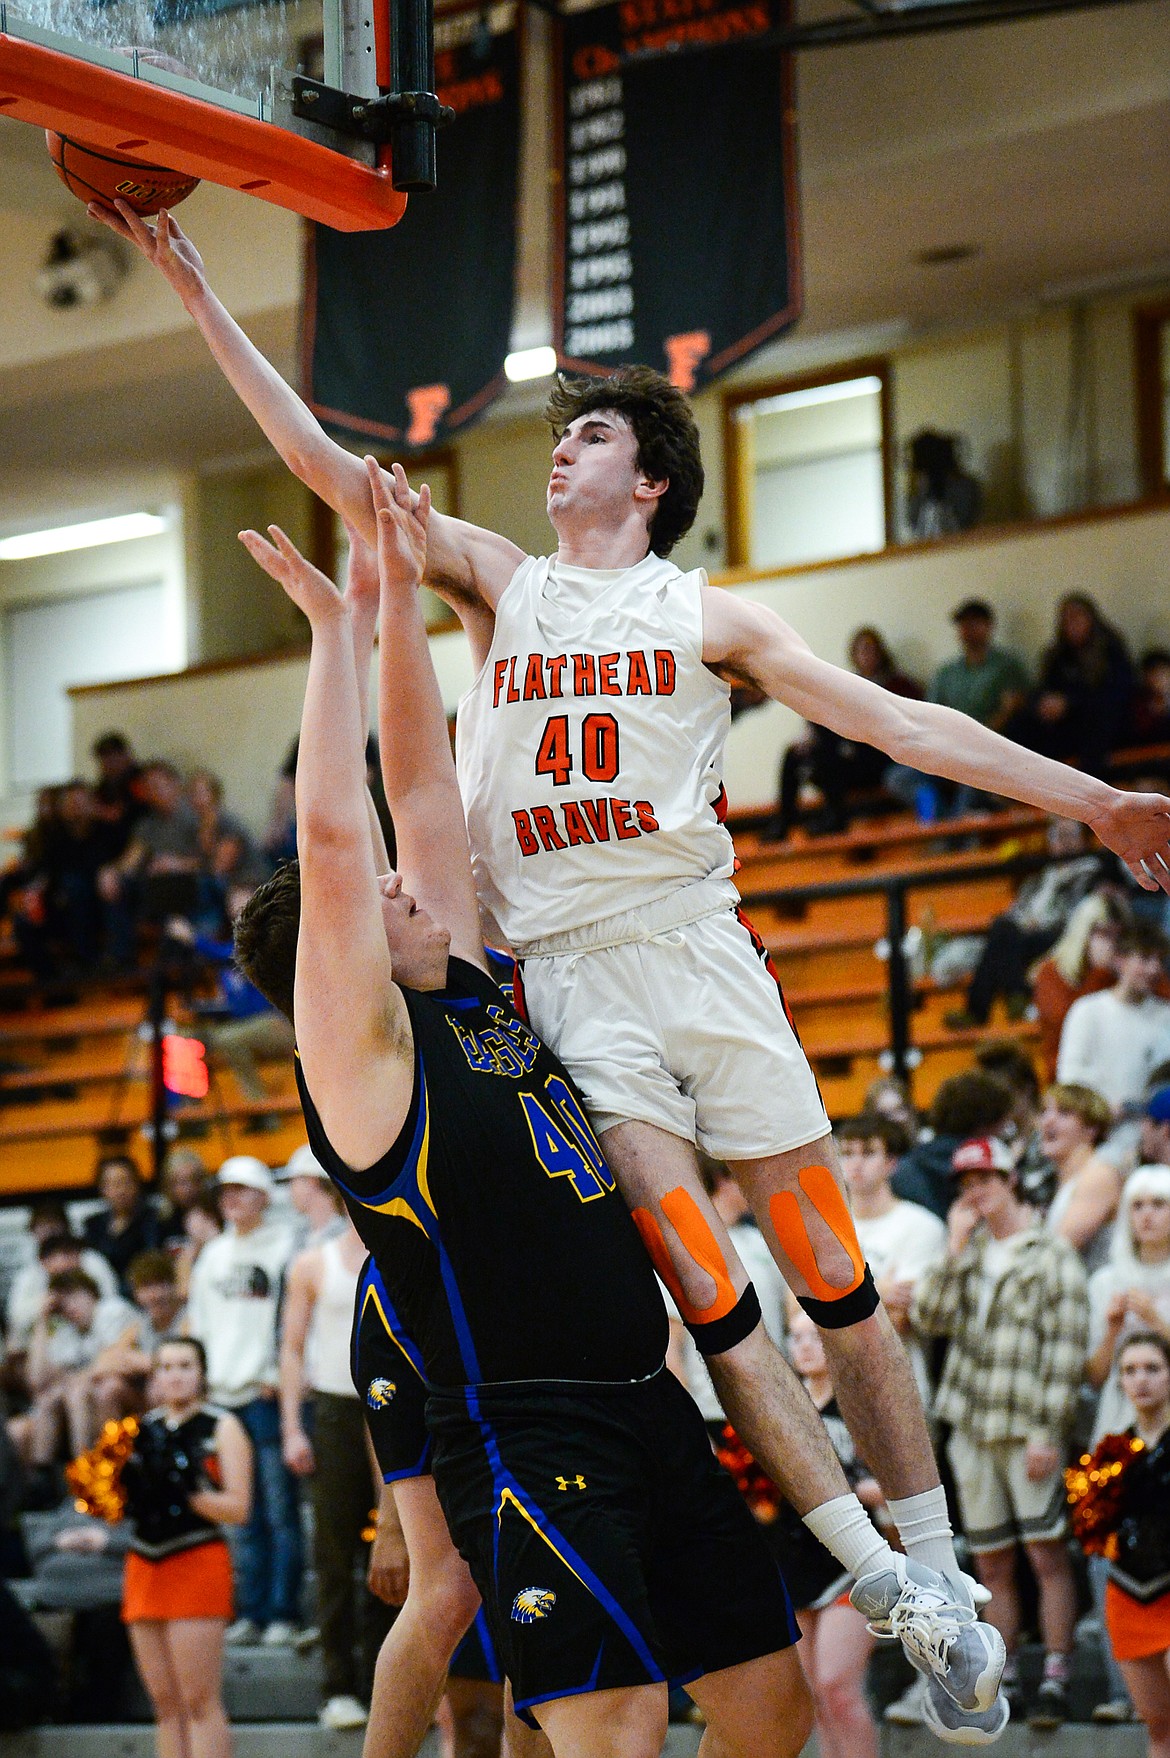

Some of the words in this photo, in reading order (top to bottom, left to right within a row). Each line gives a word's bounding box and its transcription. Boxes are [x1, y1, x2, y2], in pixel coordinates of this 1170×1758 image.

[665, 329, 711, 391] F
[405, 383, 450, 446] F
[492, 649, 677, 709] FLATHEAD
[534, 712, 621, 787] 40
[510, 797, 660, 857] BRAVES
[517, 1073, 617, 1204] 40
